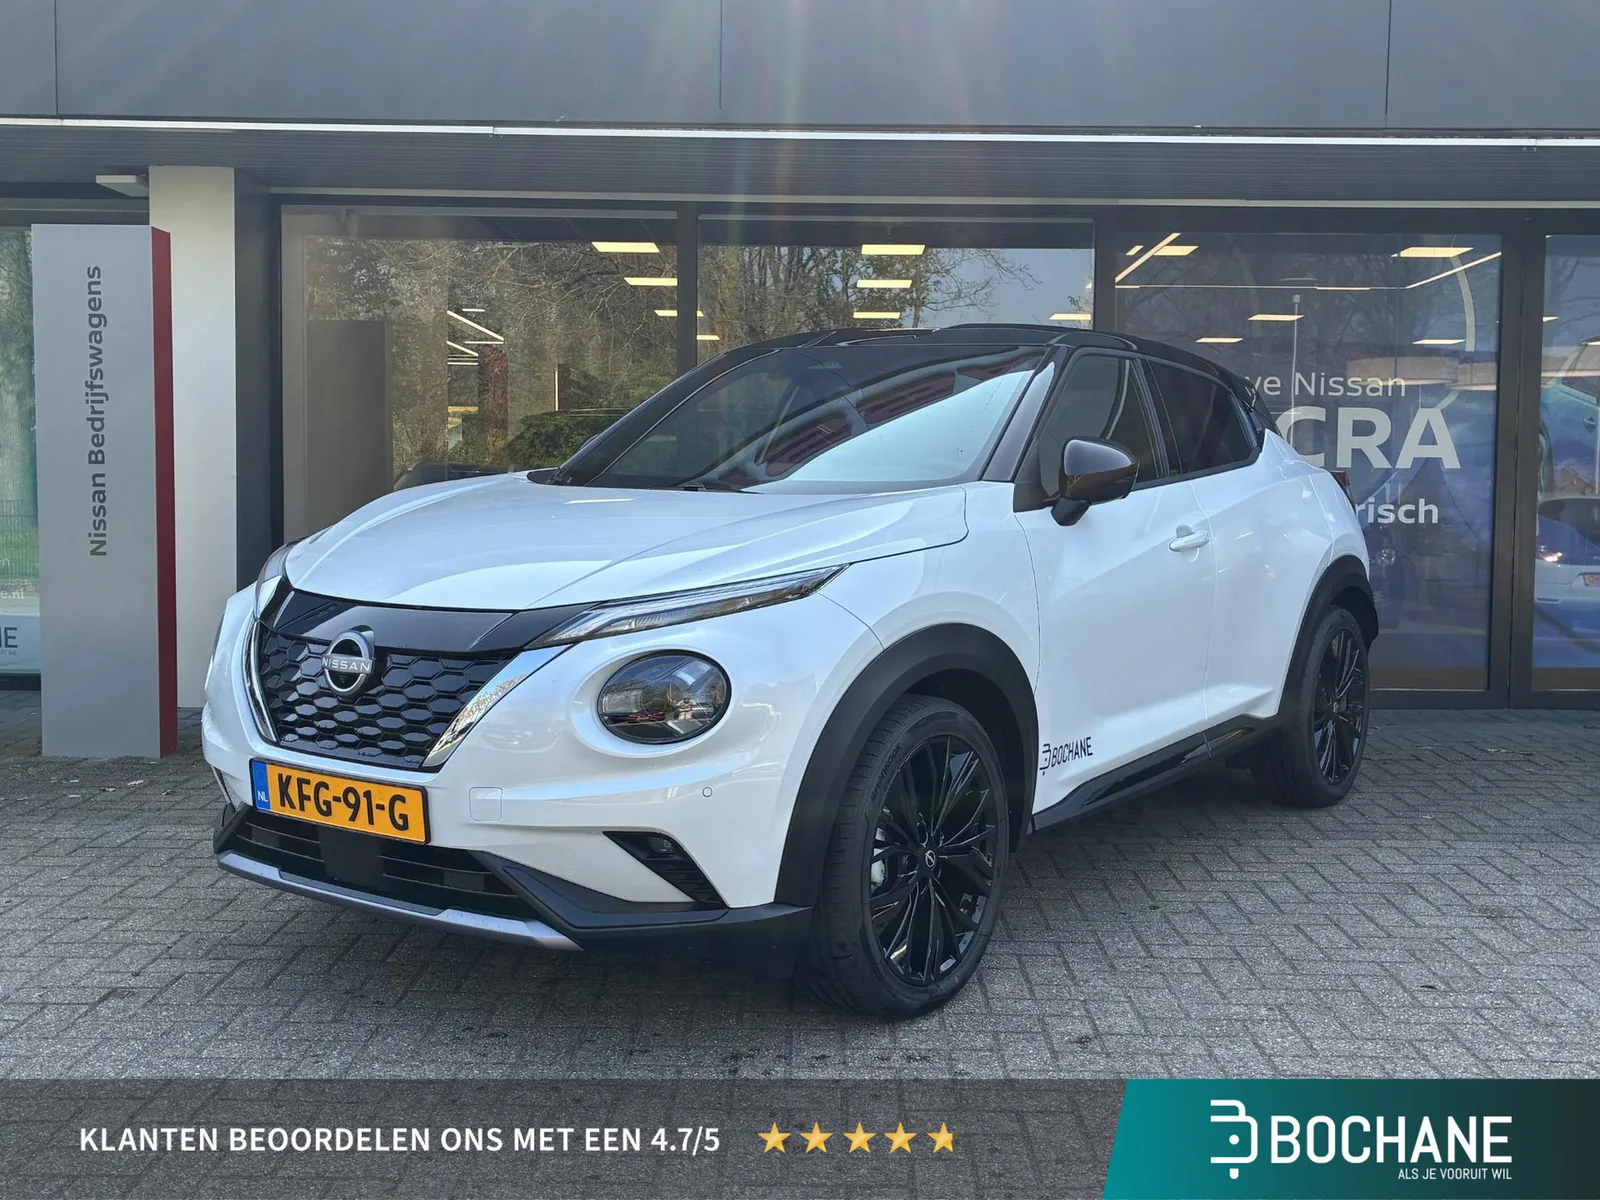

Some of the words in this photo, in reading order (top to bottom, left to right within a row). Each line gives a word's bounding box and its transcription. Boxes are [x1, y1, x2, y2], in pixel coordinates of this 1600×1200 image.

[85, 265, 110, 465] Bedrijfswagens
[1294, 372, 1406, 397] Nissan
[1275, 405, 1462, 469] CRA
[88, 472, 108, 556] Nissan
[0, 627, 18, 648] E
[321, 656, 371, 672] NISSAN
[1051, 736, 1093, 767] BOCHANE
[257, 790, 269, 803] NL
[277, 773, 410, 831] KFG-91-G
